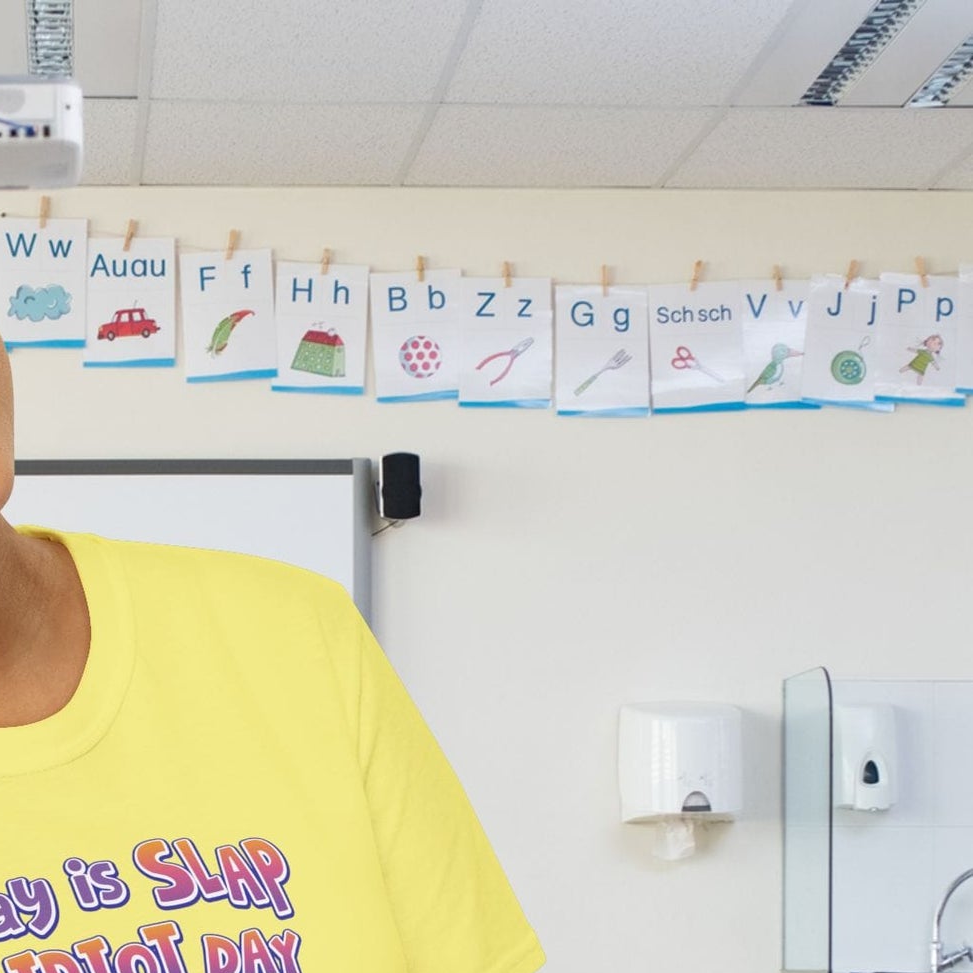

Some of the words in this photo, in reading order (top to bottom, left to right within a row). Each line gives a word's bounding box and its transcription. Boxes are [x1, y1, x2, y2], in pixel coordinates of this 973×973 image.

[4, 231, 37, 258] W
[48, 238, 73, 259] w
[90, 253, 167, 278] Auau
[198, 265, 216, 291] F
[240, 263, 253, 289] f
[291, 277, 314, 303] H
[332, 279, 351, 305] h
[387, 286, 409, 312] B
[427, 285, 447, 310] b
[897, 288, 917, 313] P
[936, 295, 956, 320] p
[475, 292, 497, 318] Z
[516, 298, 534, 319] z
[570, 300, 595, 328] G
[612, 306, 631, 333] g
[656, 304, 695, 325] Sch
[698, 303, 733, 324] sch
[746, 294, 768, 320] V
[788, 300, 805, 319] v
[827, 291, 843, 318] J
[867, 296, 878, 326] j
[63, 857, 130, 912] is
[133, 836, 293, 920] SLAP
